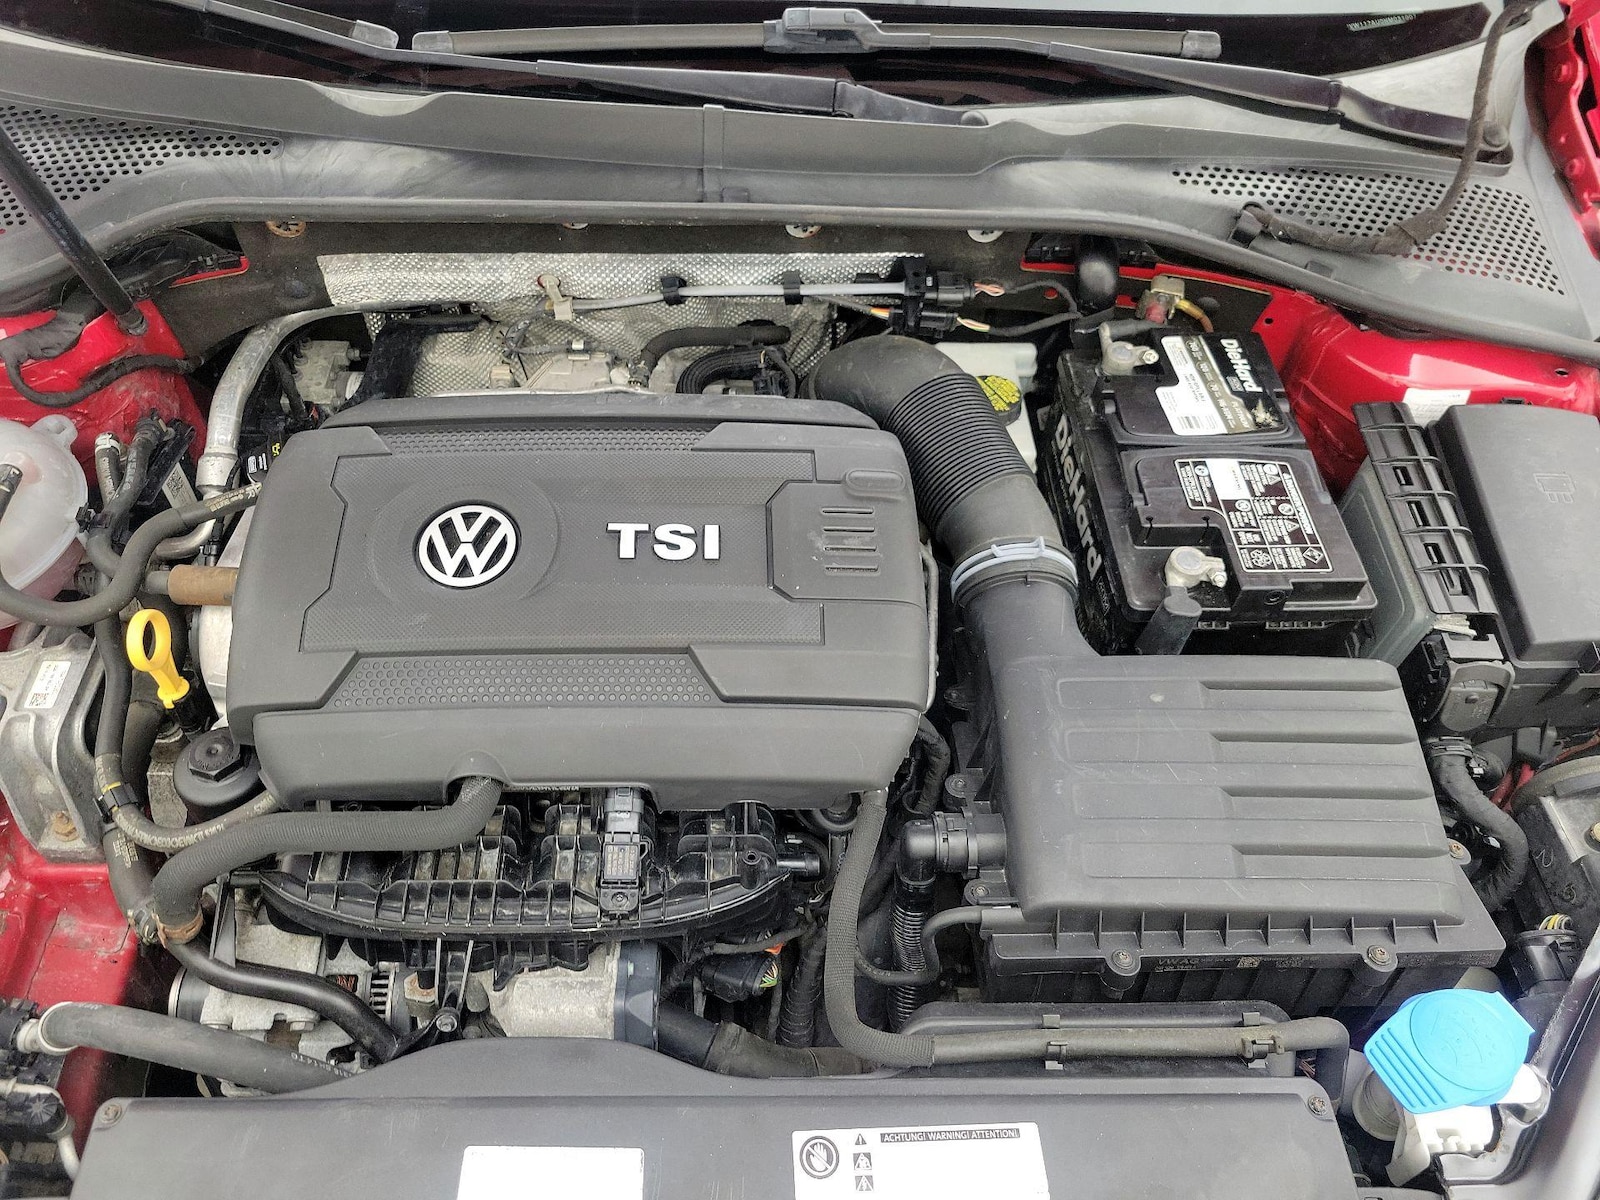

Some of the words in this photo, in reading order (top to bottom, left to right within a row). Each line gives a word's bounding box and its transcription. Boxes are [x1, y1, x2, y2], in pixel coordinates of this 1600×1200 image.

[1220, 338, 1262, 392] DieHard
[1056, 414, 1102, 581] DieHard
[419, 505, 516, 587] VW
[606, 522, 721, 561] TSI
[884, 1132, 926, 1143] ACHTUNG!
[928, 1130, 970, 1141] WARNING!
[971, 1128, 1018, 1140] ATTENTION!
